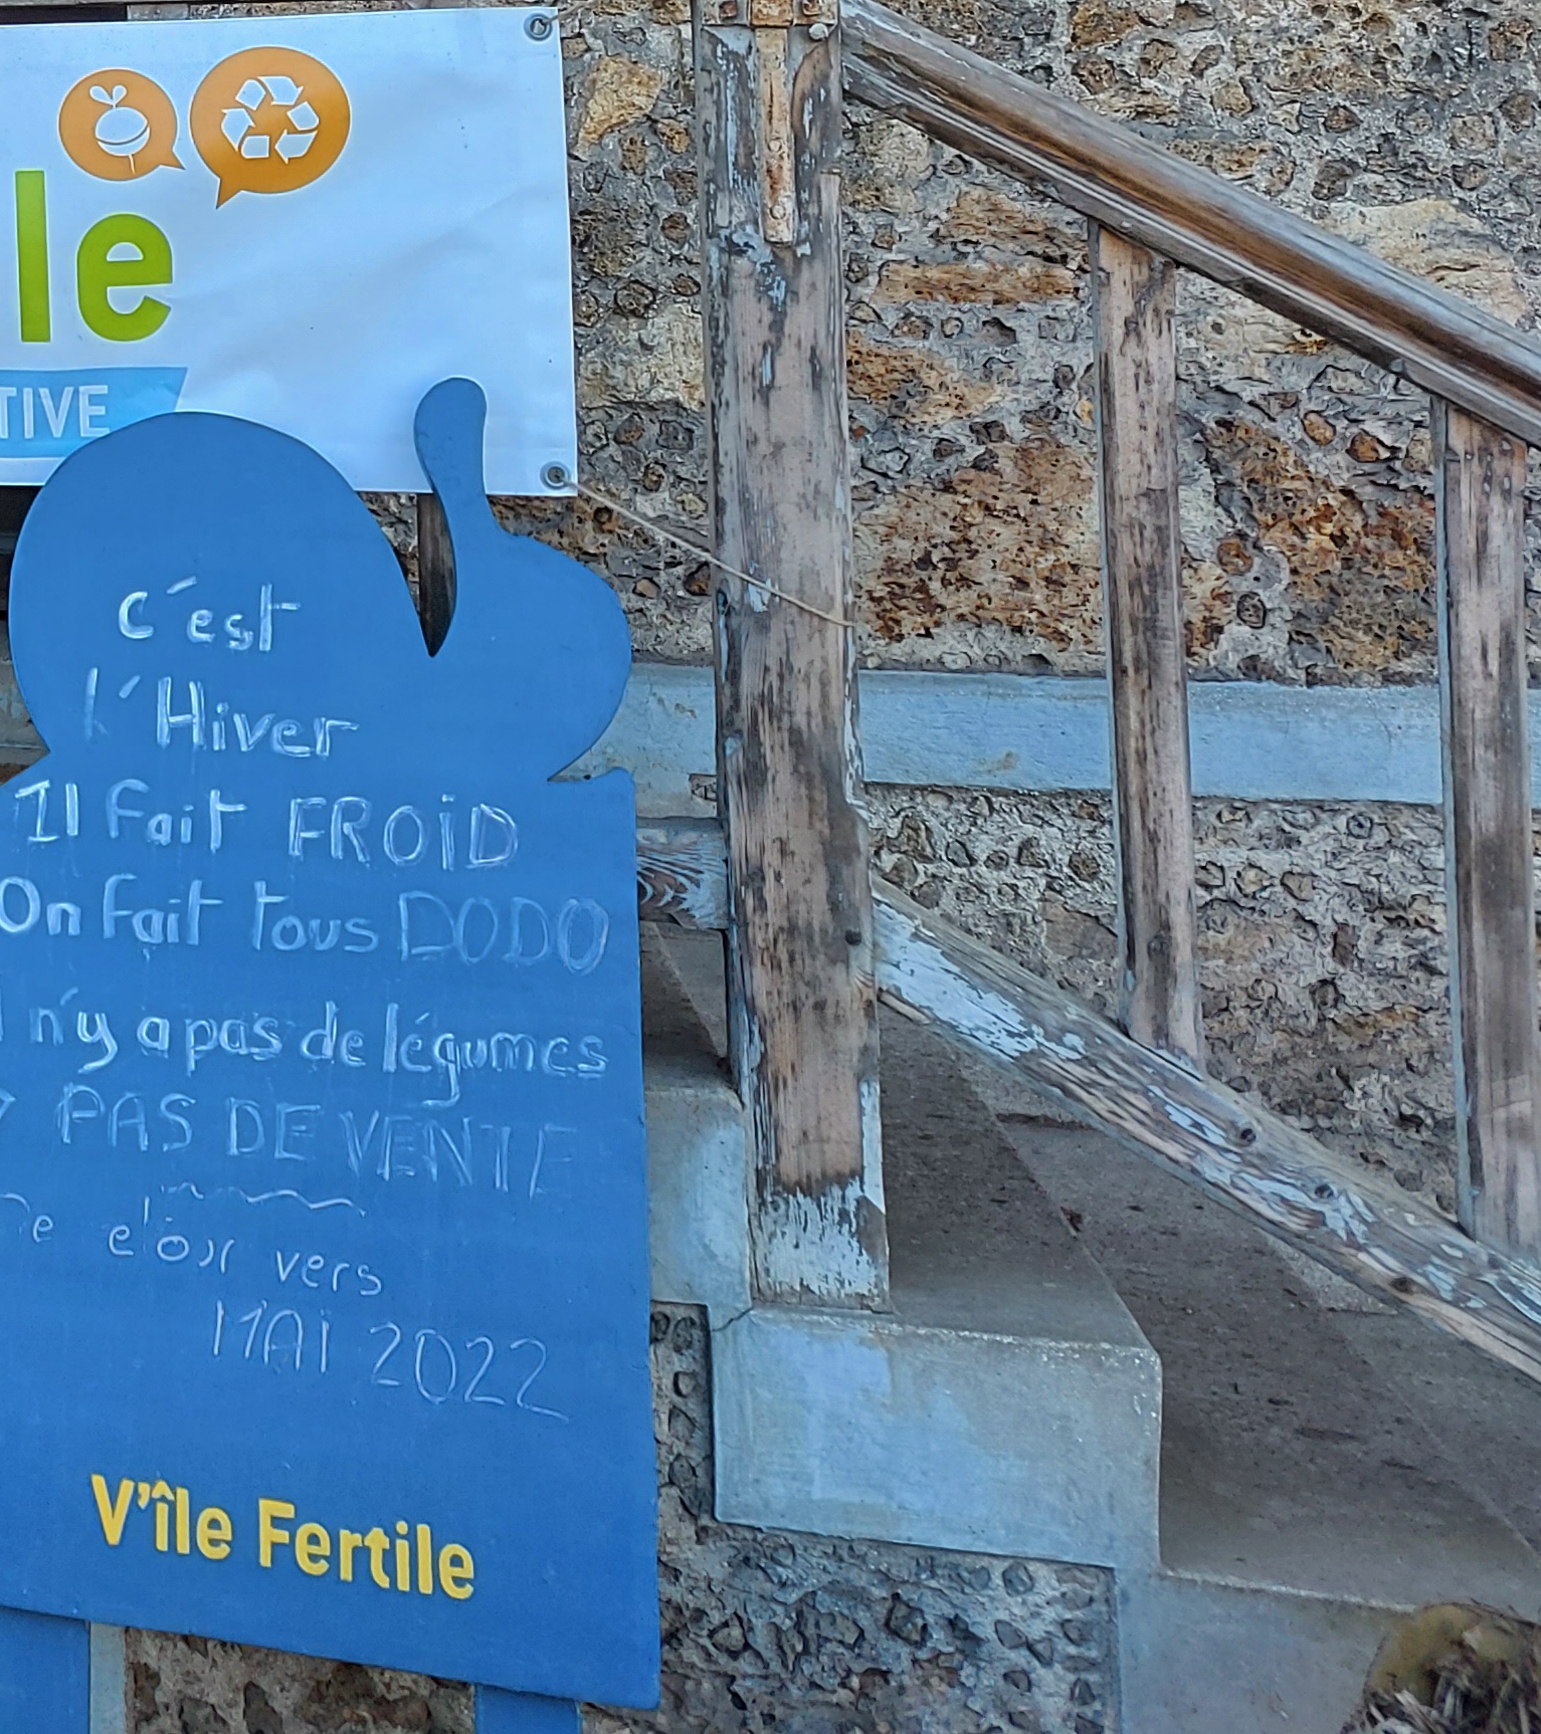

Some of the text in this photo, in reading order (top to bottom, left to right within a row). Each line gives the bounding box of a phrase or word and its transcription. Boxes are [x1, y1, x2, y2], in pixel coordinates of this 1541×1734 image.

[15, 780, 79, 844] Il
[106, 778, 248, 854] fait
[103, 873, 224, 947] fait
[251, 880, 380, 952] tous
[399, 891, 611, 975] DODO
[29, 987, 118, 1074] n'y
[136, 1015, 170, 1058] a
[184, 1013, 283, 1076] pas
[300, 1000, 367, 1068] de
[382, 1002, 610, 1107] légumes
[56, 1082, 578, 1203] PAS DE VENTE
[277, 1250, 383, 1296] vers
[369, 1321, 570, 1422] 2022
[258, 1497, 476, 1601] Fertile
